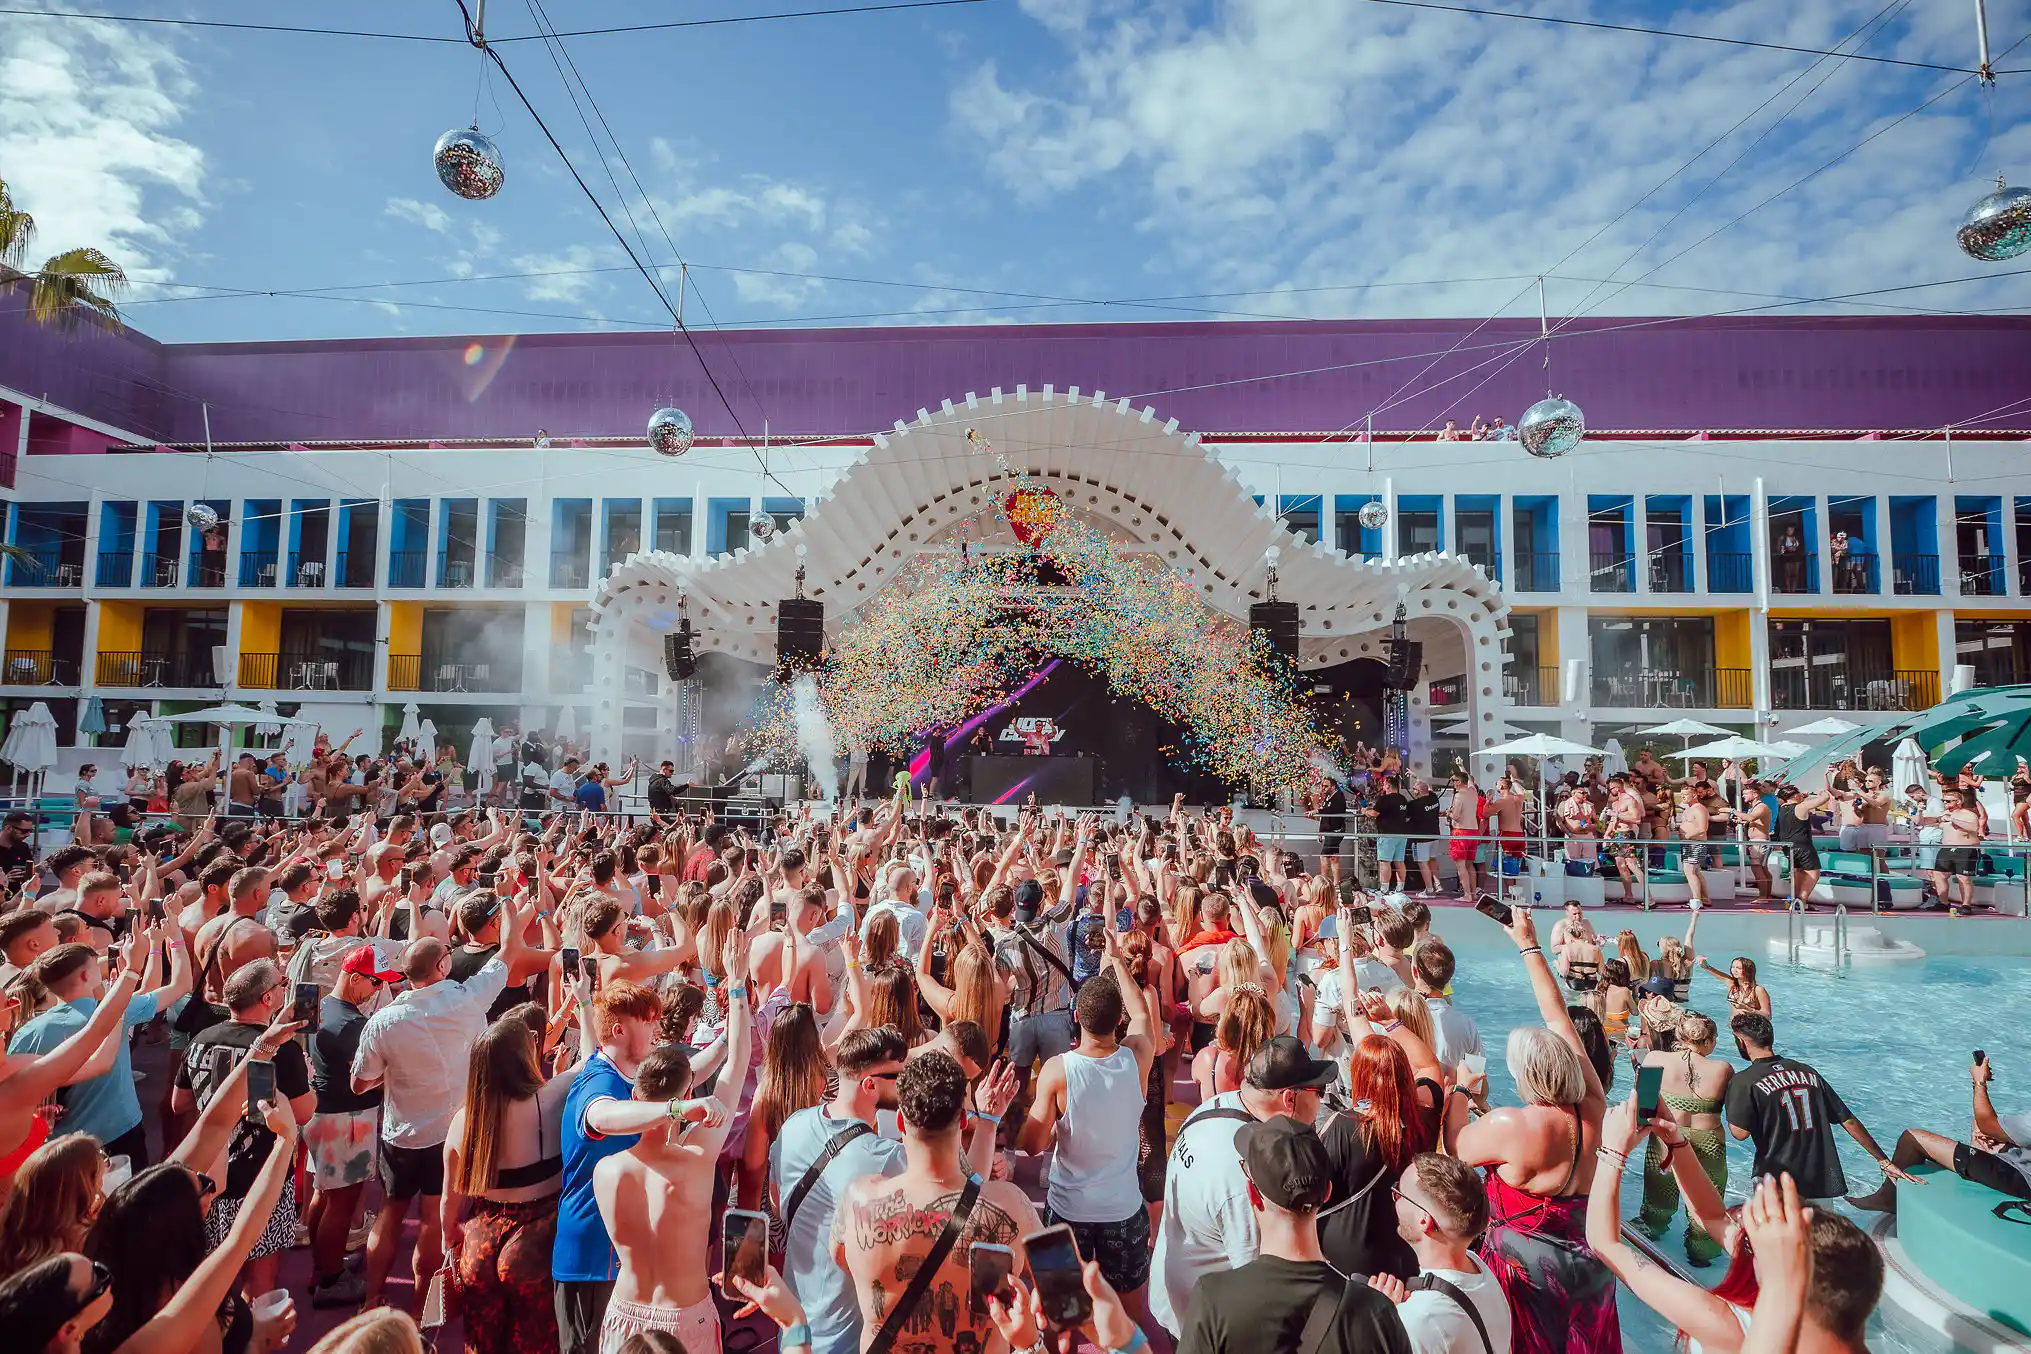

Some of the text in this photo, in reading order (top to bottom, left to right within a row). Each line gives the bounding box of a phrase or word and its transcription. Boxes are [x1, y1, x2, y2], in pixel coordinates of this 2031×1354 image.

[1754, 1069, 1818, 1095] BERKMAN
[1780, 1087, 1814, 1132] 17
[1177, 1132, 1194, 1169] TIALS
